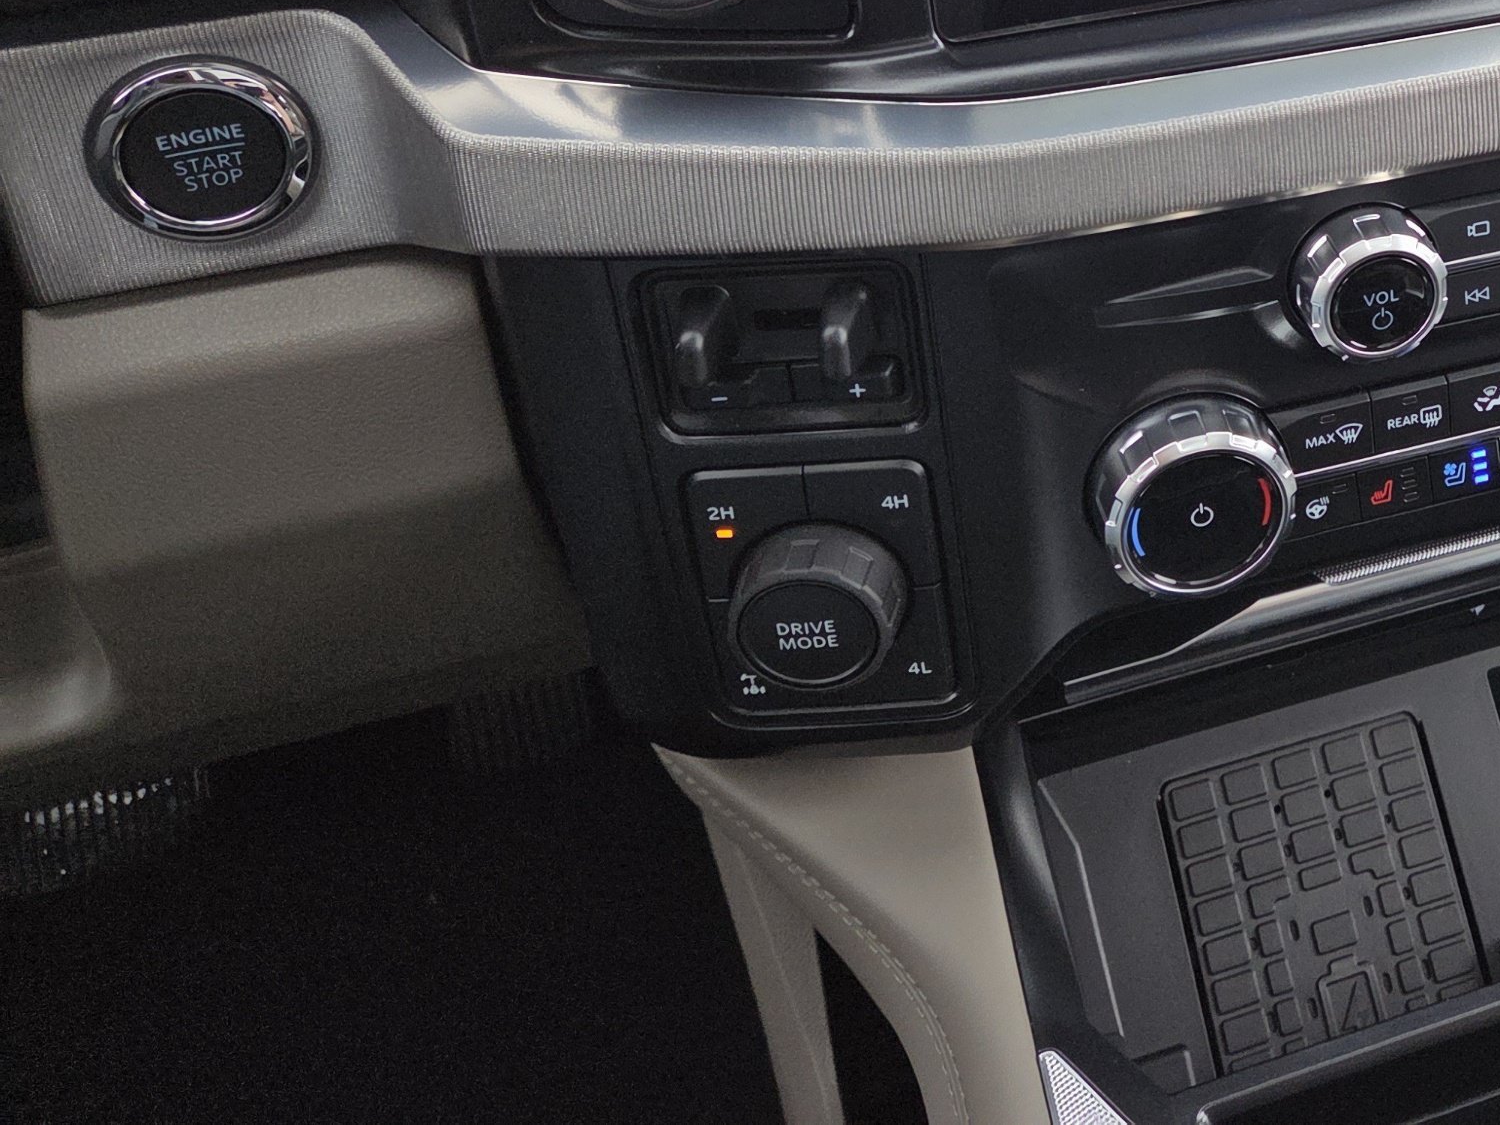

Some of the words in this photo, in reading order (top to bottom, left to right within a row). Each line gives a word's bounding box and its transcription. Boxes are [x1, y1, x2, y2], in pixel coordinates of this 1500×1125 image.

[155, 123, 245, 152] ENGINE
[174, 151, 243, 176] START
[184, 168, 244, 192] STOP
[1363, 288, 1400, 307] VOL
[1387, 412, 1420, 430] REAR
[1305, 433, 1337, 449] MAX
[881, 494, 909, 510] 4H
[707, 506, 735, 522] 2H
[776, 619, 836, 635] DRIVE
[778, 634, 839, 650] MODE
[907, 661, 932, 675] 4L
